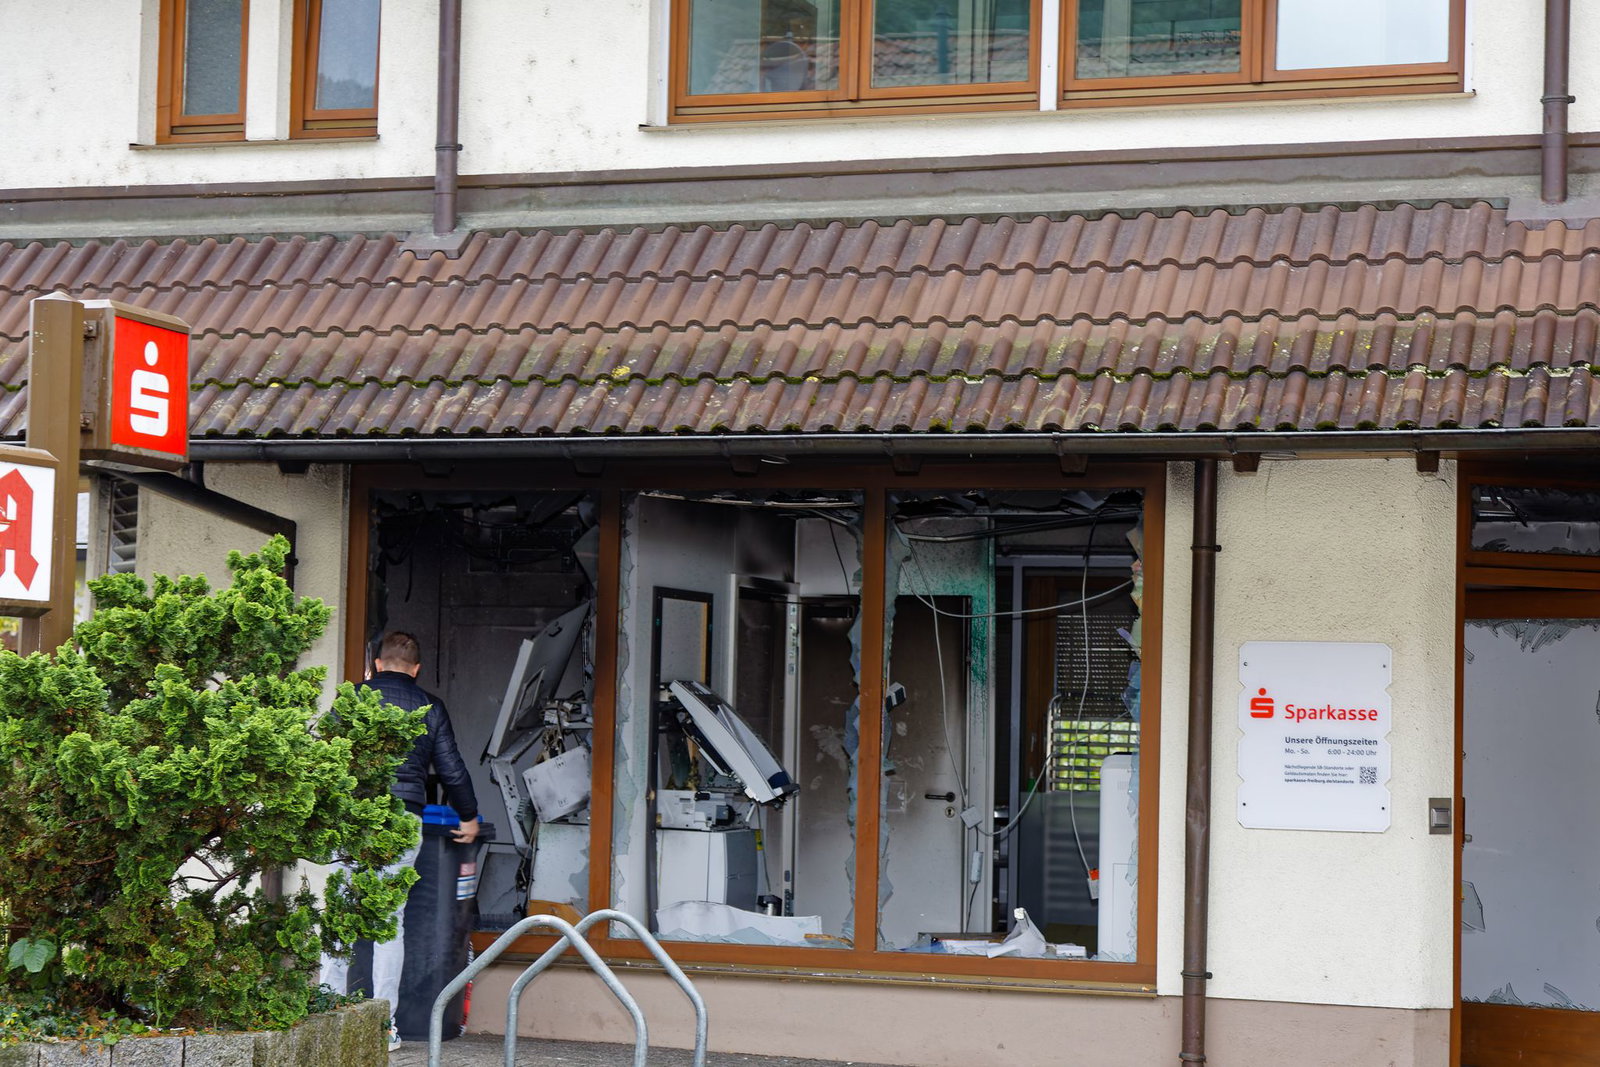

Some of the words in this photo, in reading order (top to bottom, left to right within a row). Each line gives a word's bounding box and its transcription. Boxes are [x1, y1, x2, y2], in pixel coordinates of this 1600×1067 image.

[1284, 704, 1378, 723] Sparkasse
[1284, 736, 1314, 744] Unsere
[1315, 735, 1378, 746] Öffnungszeiten
